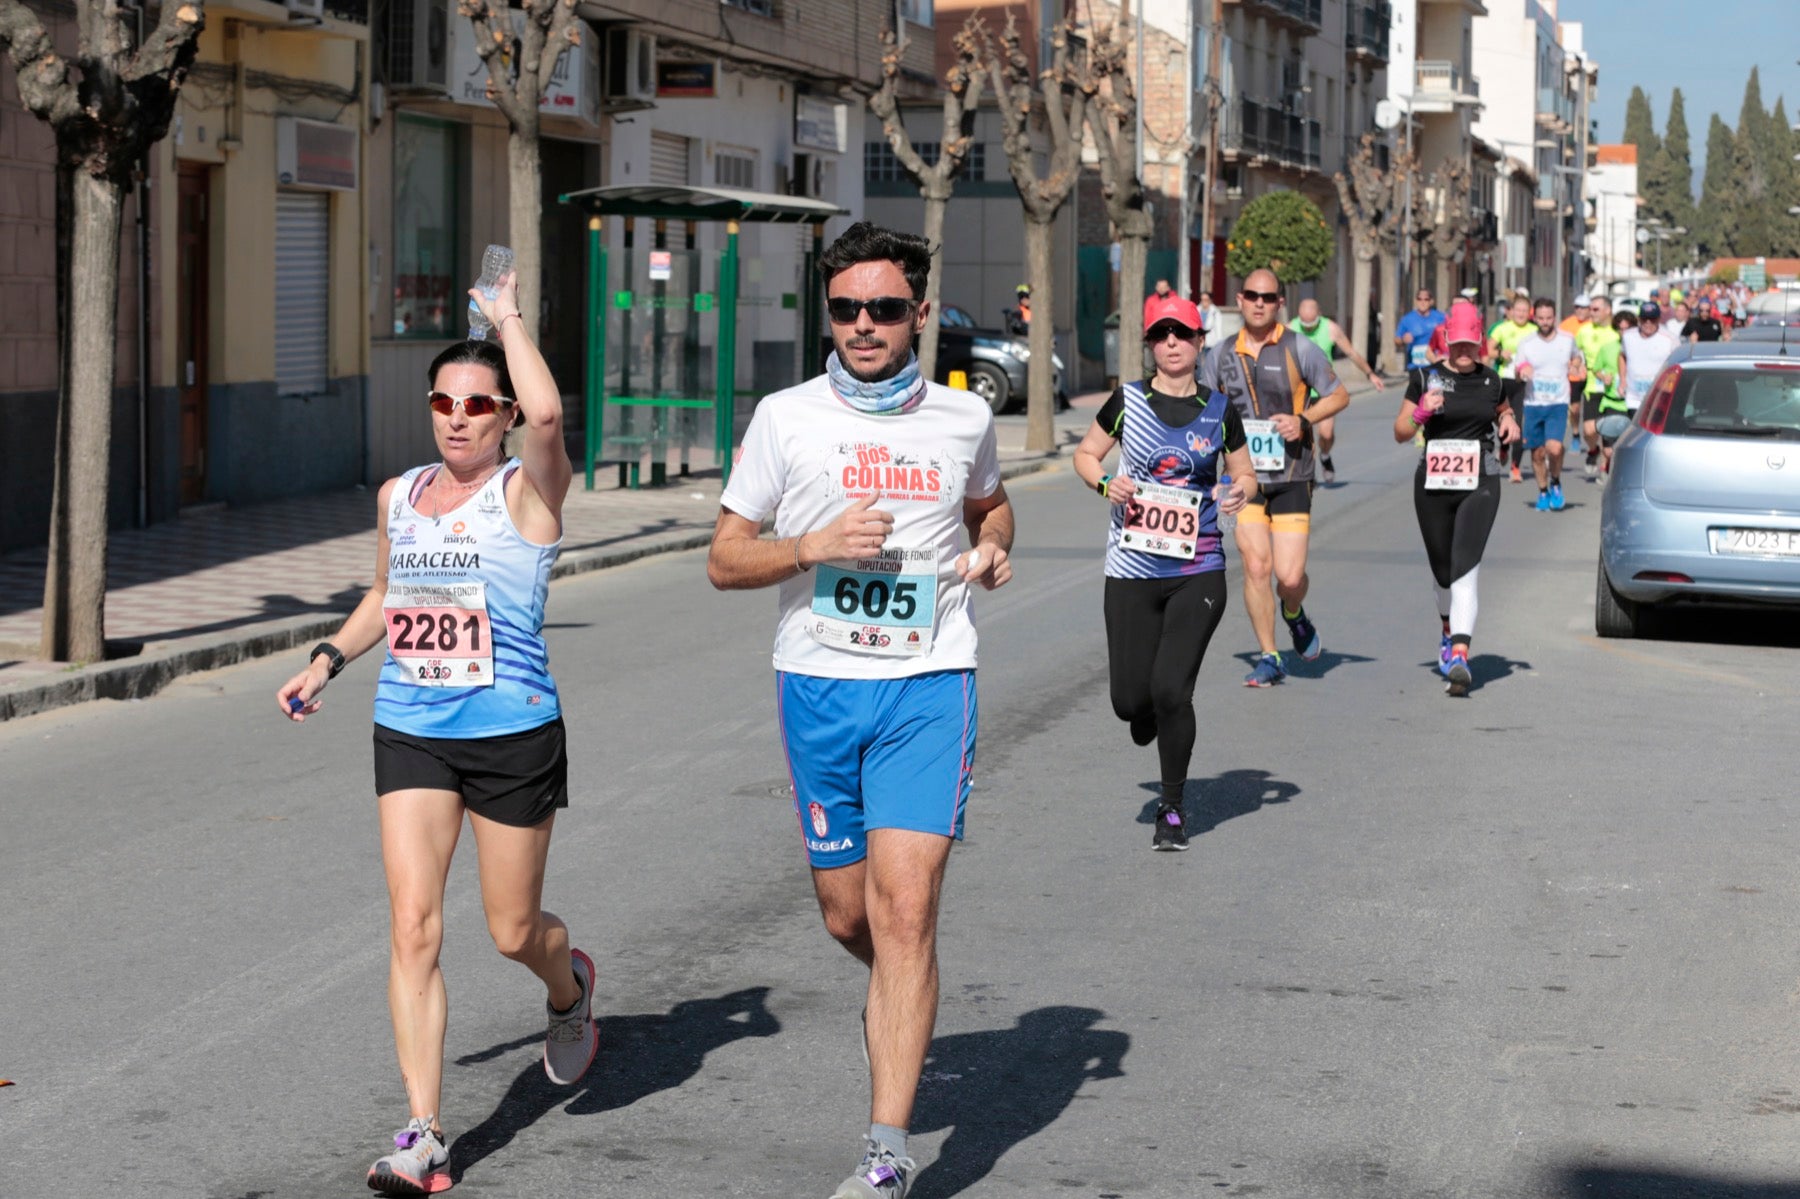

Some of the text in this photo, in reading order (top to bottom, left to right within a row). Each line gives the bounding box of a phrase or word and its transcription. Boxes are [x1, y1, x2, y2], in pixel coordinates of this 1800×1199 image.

[856, 446, 891, 467] DOS
[1430, 455, 1474, 473] 2221
[842, 465, 941, 492] COLINAS
[911, 494, 939, 502] ARMADAS
[1128, 503, 1195, 536] 2003
[1734, 529, 1780, 549] 7023
[901, 551, 908, 560] DE
[911, 551, 932, 561] FONDO
[395, 571, 410, 579] CLUB
[403, 585, 420, 596] GRAN
[453, 585, 478, 597] FONDO
[834, 576, 917, 621] 605
[392, 613, 480, 651] 2281
[806, 837, 853, 851] LEGEA
